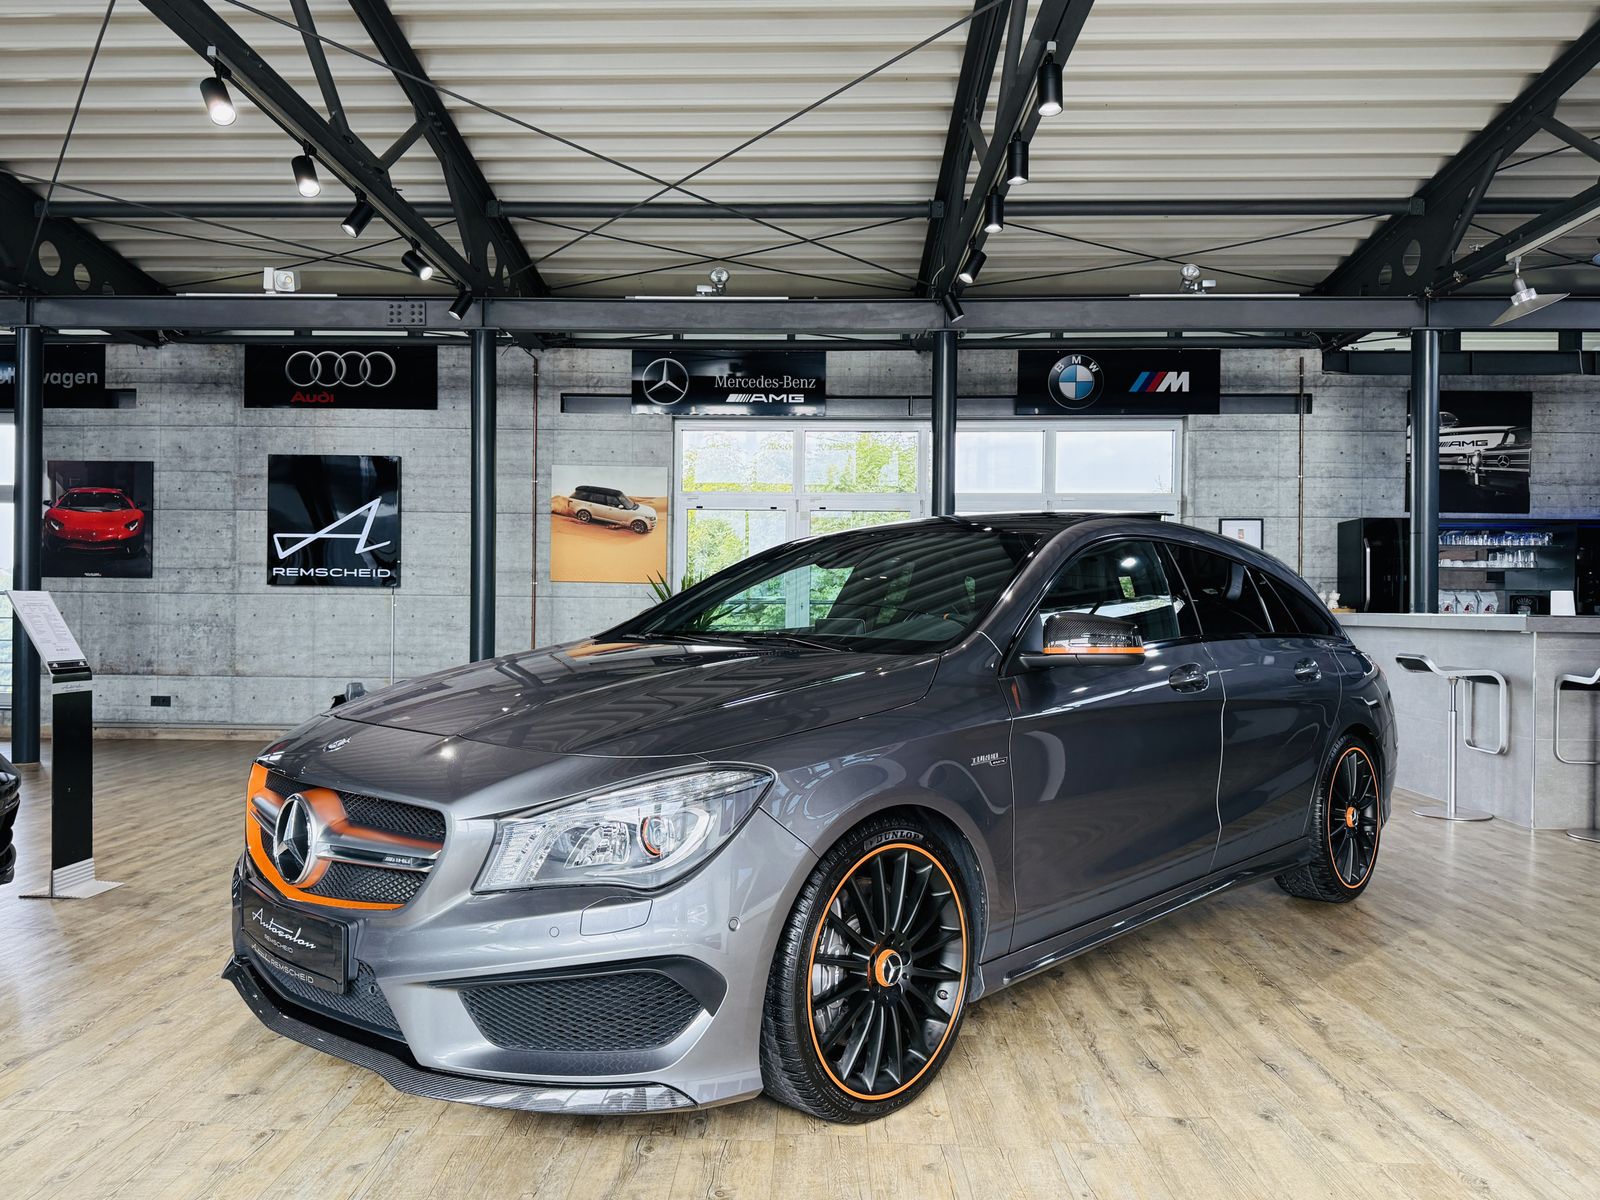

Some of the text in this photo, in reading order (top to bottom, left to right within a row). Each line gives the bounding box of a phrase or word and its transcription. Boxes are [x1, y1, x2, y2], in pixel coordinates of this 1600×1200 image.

[1054, 355, 1100, 373] BMW
[714, 375, 816, 389] Mercedes-Benz
[290, 391, 335, 403] Audi
[749, 393, 805, 403] AMG
[1448, 439, 1489, 448] AMG
[272, 567, 391, 578] REMSCHEID
[876, 830, 920, 844] DUNLOP
[251, 907, 317, 949] Autosalon
[270, 958, 315, 984] REMSCHEID
